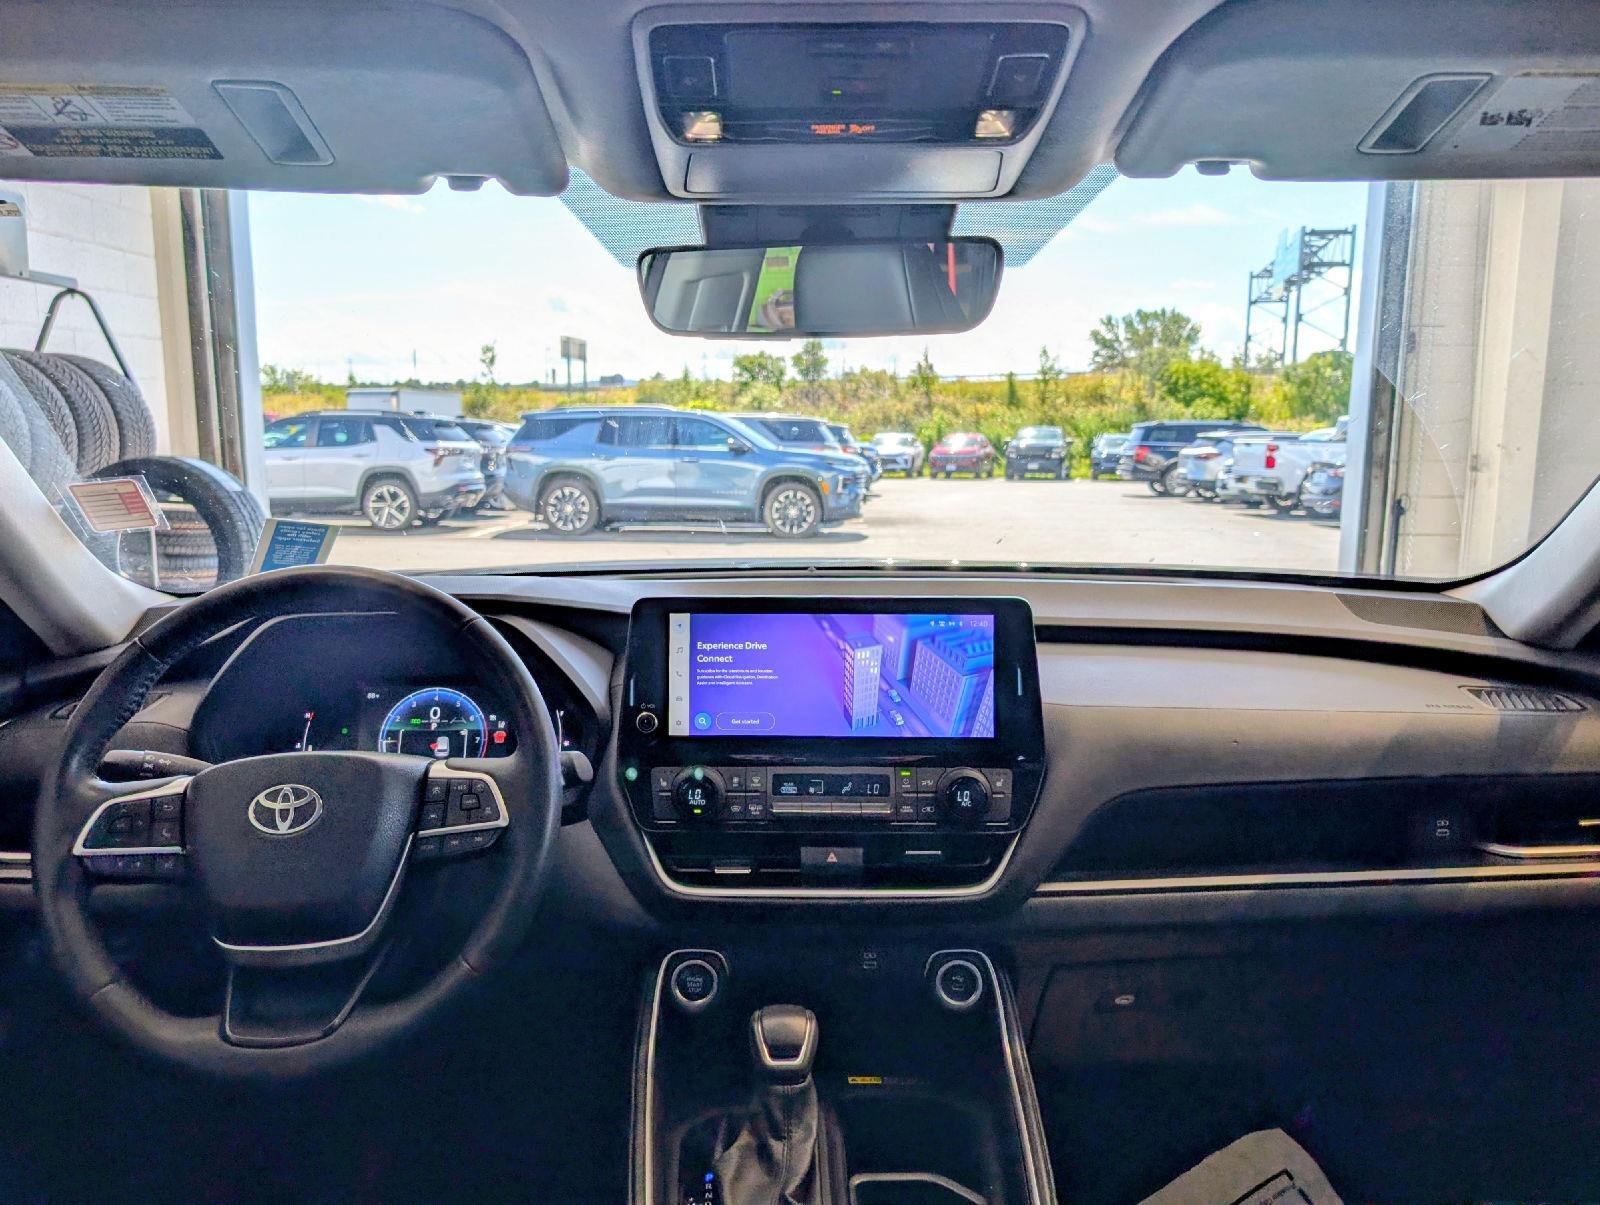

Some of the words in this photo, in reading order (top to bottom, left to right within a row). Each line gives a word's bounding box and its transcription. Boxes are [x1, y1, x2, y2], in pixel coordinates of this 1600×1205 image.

[697, 642, 744, 651] Experience
[745, 642, 768, 650] Drive
[697, 654, 733, 662] Connect
[430, 706, 440, 719] 0
[867, 784, 880, 793] LO
[689, 789, 701, 799] LO
[957, 791, 970, 801] LO
